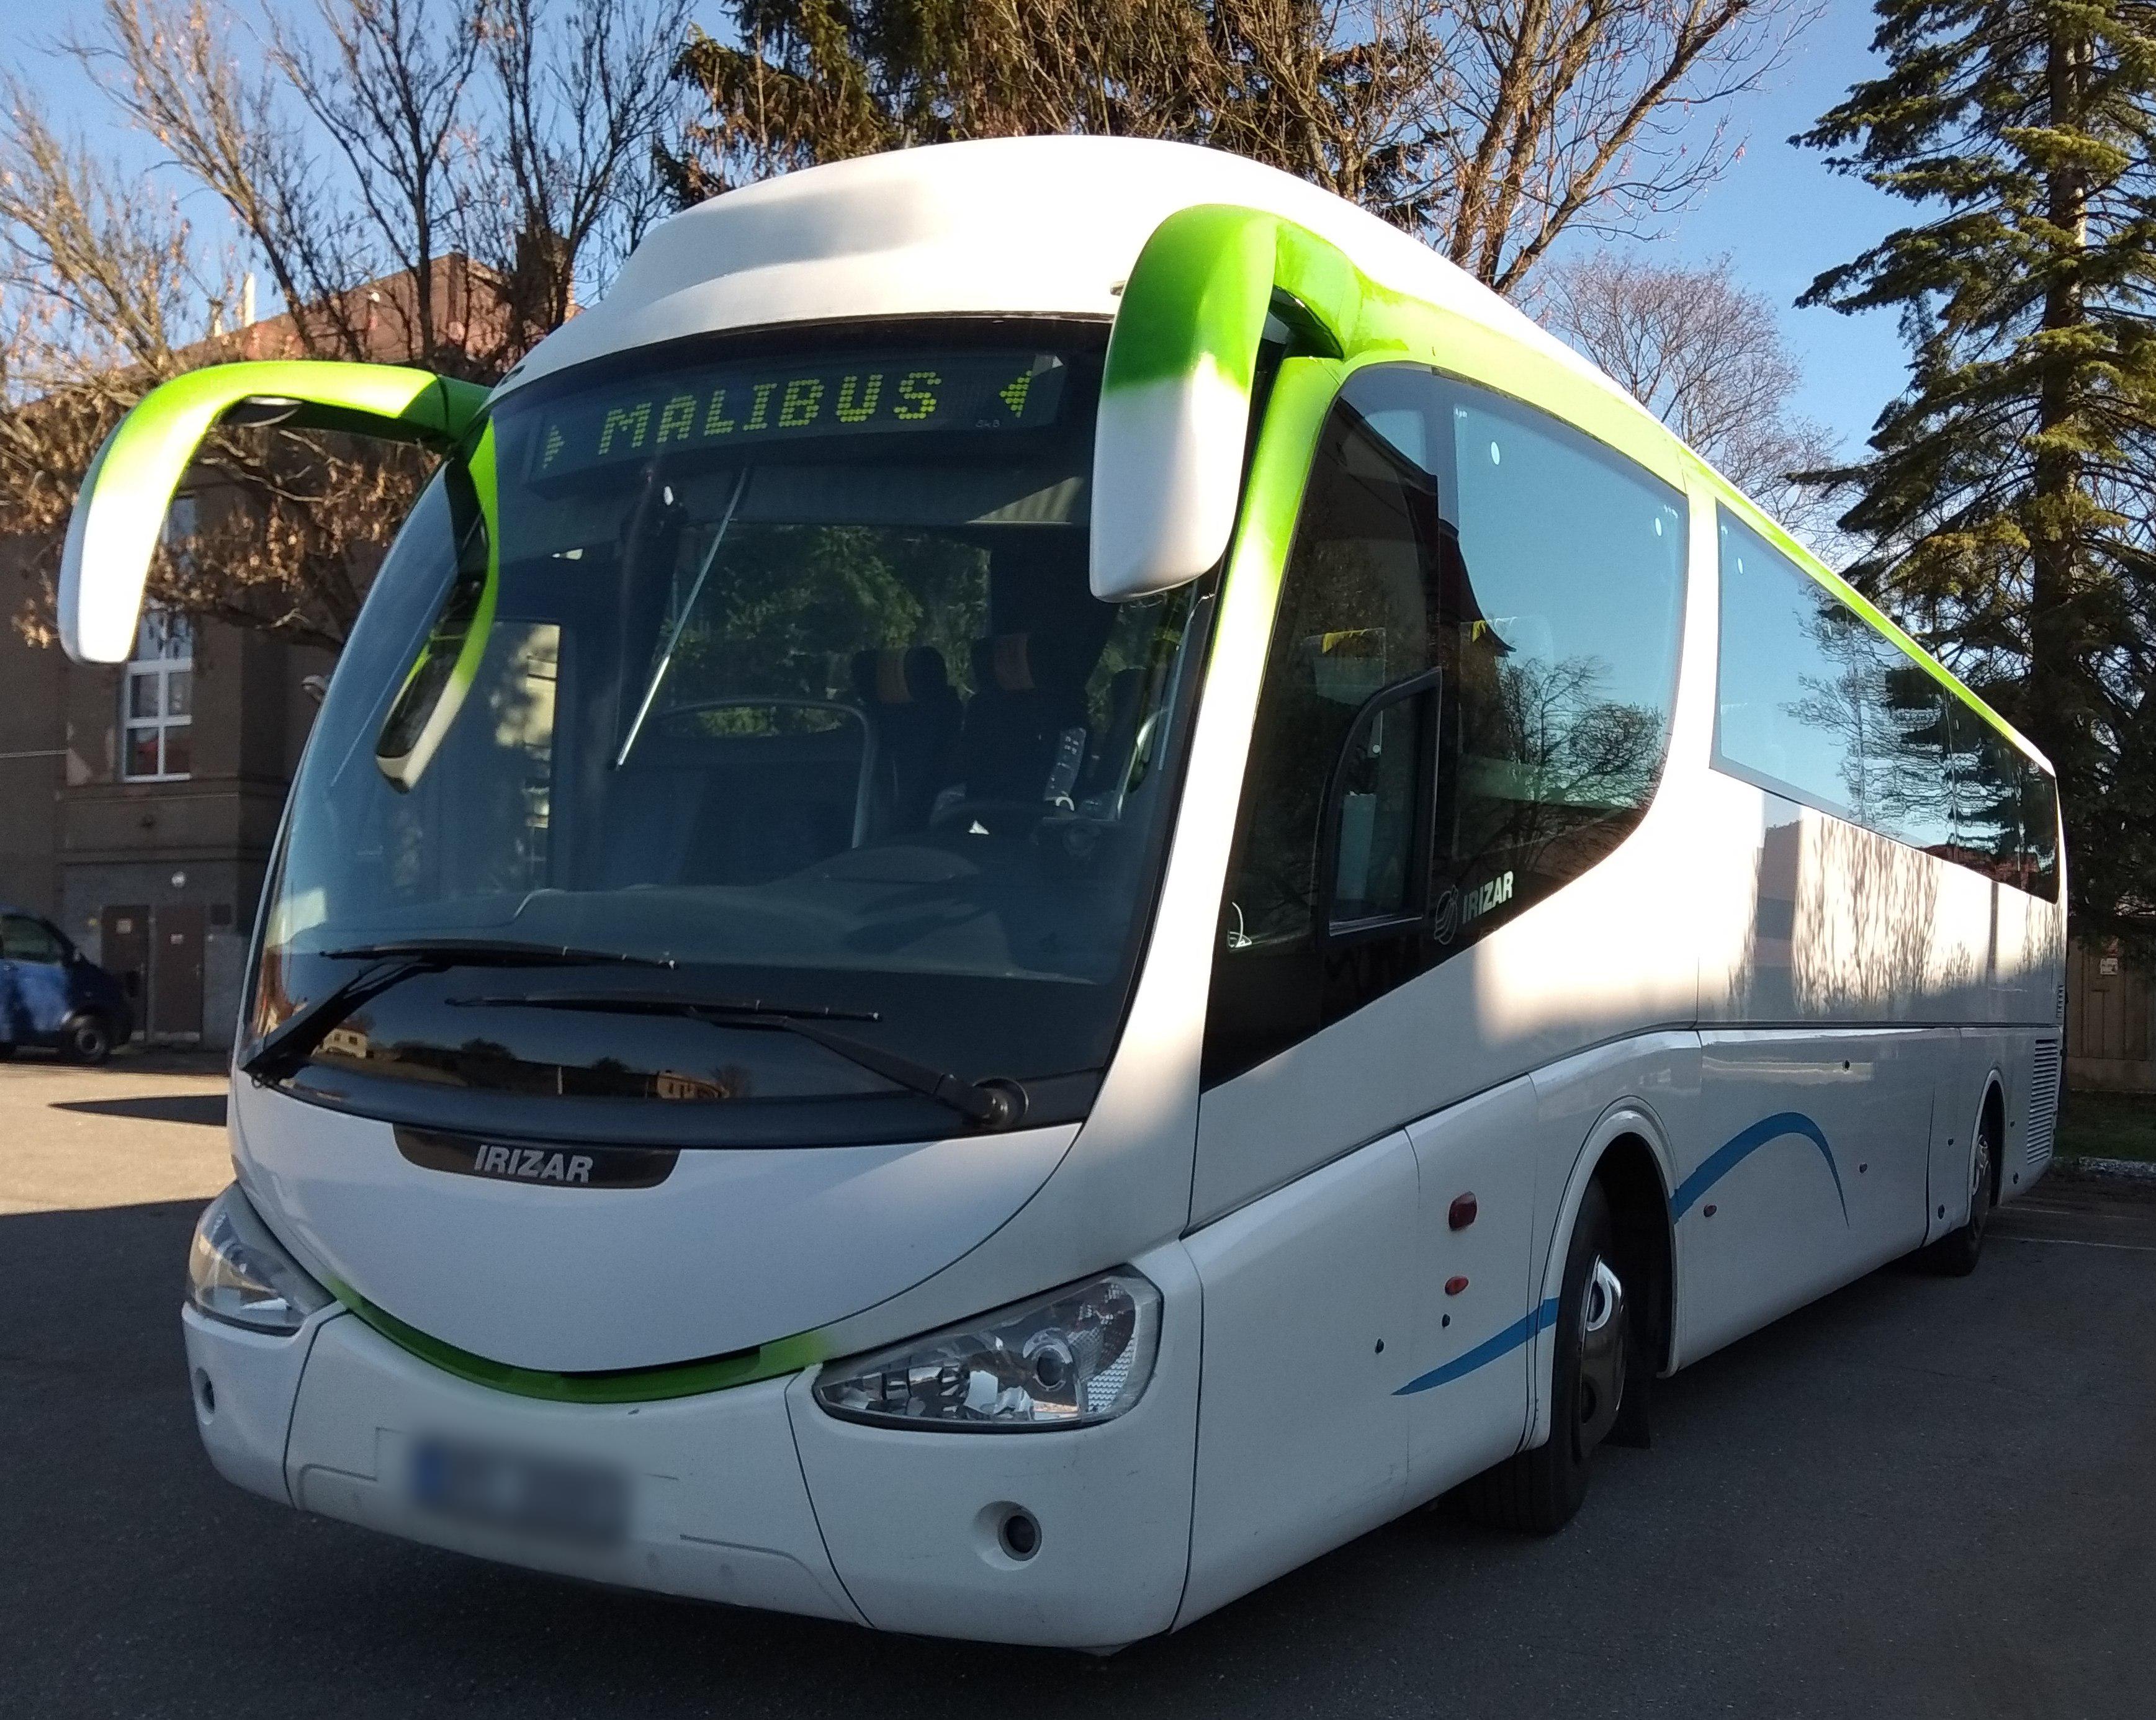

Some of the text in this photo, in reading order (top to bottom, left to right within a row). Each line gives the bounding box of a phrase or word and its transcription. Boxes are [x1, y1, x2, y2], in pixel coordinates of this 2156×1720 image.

[598, 372, 941, 455] MALIBUS
[1462, 871, 1514, 925] IRIZAR
[475, 1145, 593, 1183] IRIZAR
